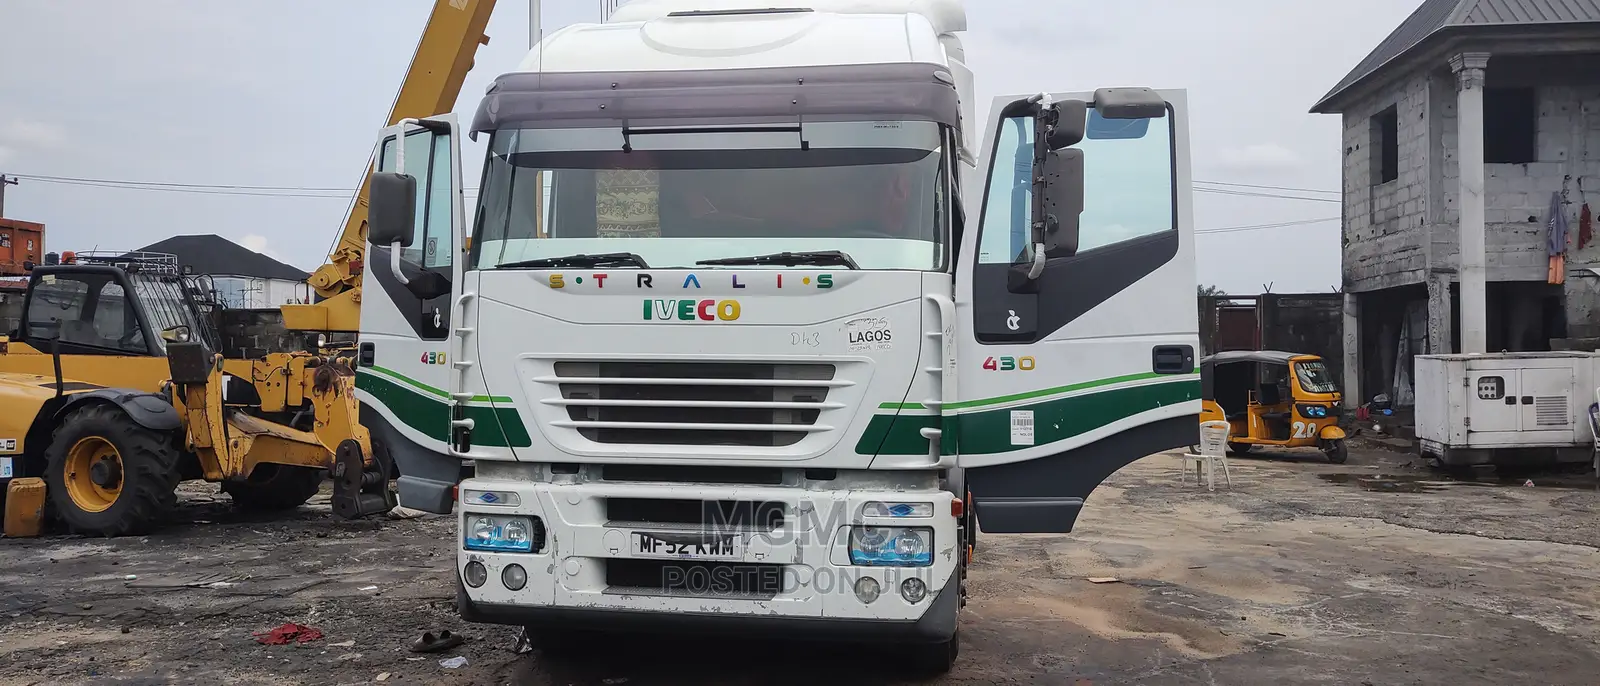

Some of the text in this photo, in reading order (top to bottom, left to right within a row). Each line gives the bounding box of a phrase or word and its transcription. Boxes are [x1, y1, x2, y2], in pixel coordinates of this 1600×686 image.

[643, 299, 742, 321] IVECO
[849, 329, 892, 344] LAGOS
[420, 351, 447, 365] 430
[982, 355, 1036, 371] 430
[1292, 421, 1317, 439] 20
[640, 534, 734, 556] MF52 KWM
